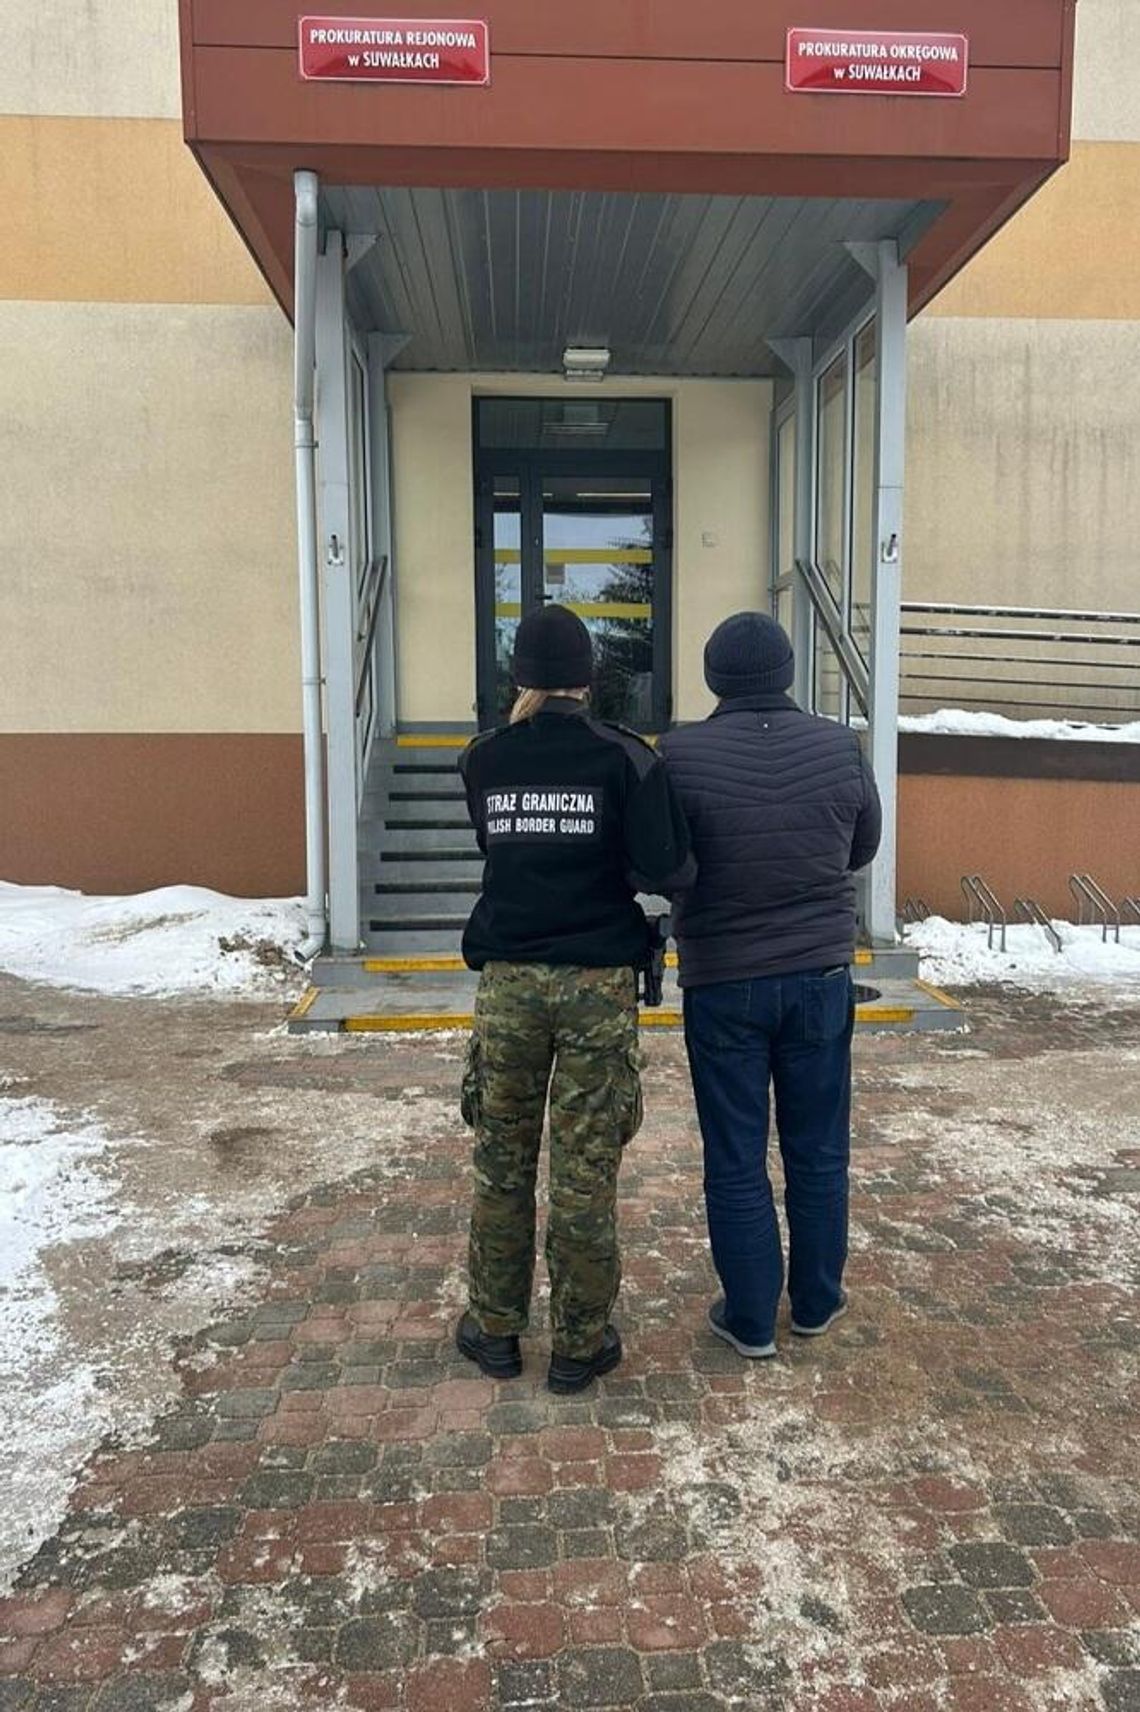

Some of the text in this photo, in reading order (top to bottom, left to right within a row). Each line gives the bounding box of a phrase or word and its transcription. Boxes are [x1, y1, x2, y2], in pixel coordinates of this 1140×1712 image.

[310, 29, 476, 48] PROKURATURA REJONOWA
[348, 51, 440, 69] w SUWAŁKACH
[798, 42, 958, 63] PROKURATURA OKRĘGOWA
[834, 64, 921, 81] w SUWAŁKACH
[522, 792, 594, 813] GRANICZNA
[487, 817, 595, 834] LISH BORDER GUARD
